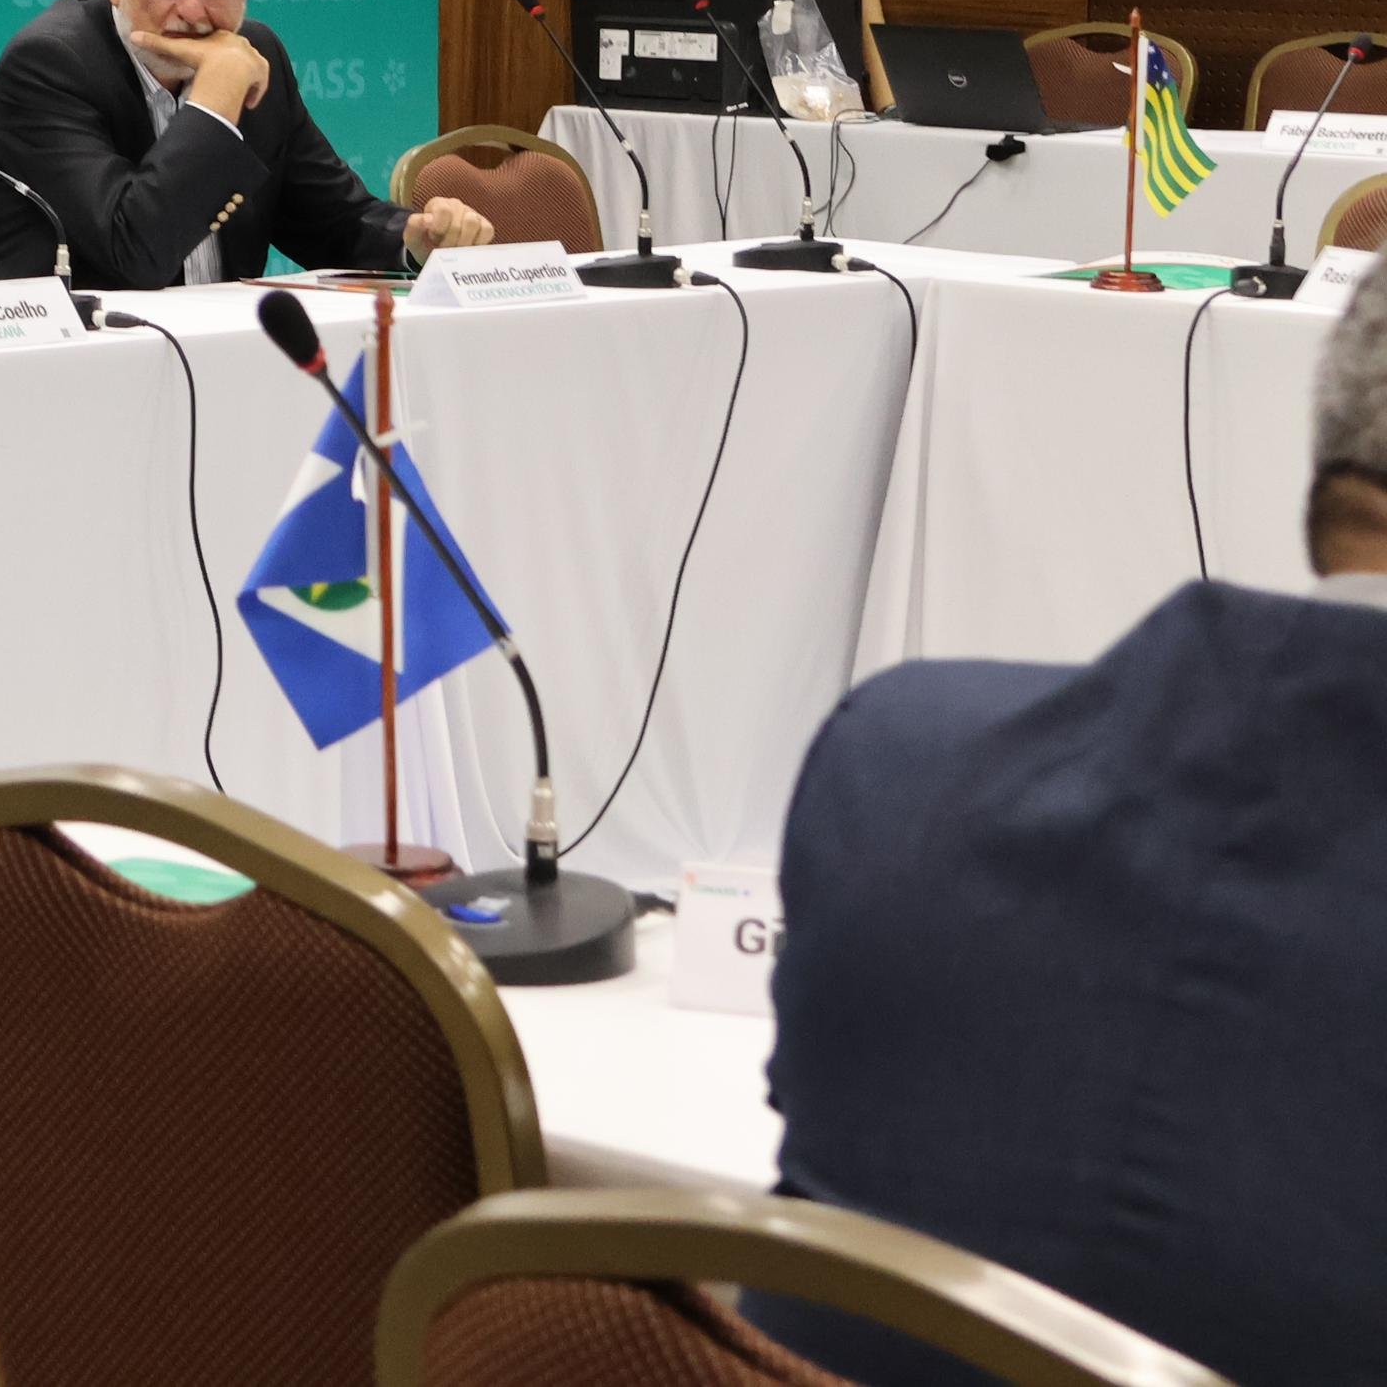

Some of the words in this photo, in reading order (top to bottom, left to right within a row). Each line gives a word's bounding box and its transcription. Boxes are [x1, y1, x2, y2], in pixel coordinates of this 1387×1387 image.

[292, 58, 365, 100] ASS
[452, 267, 509, 286] Fernando
[511, 263, 567, 284] Cupertino
